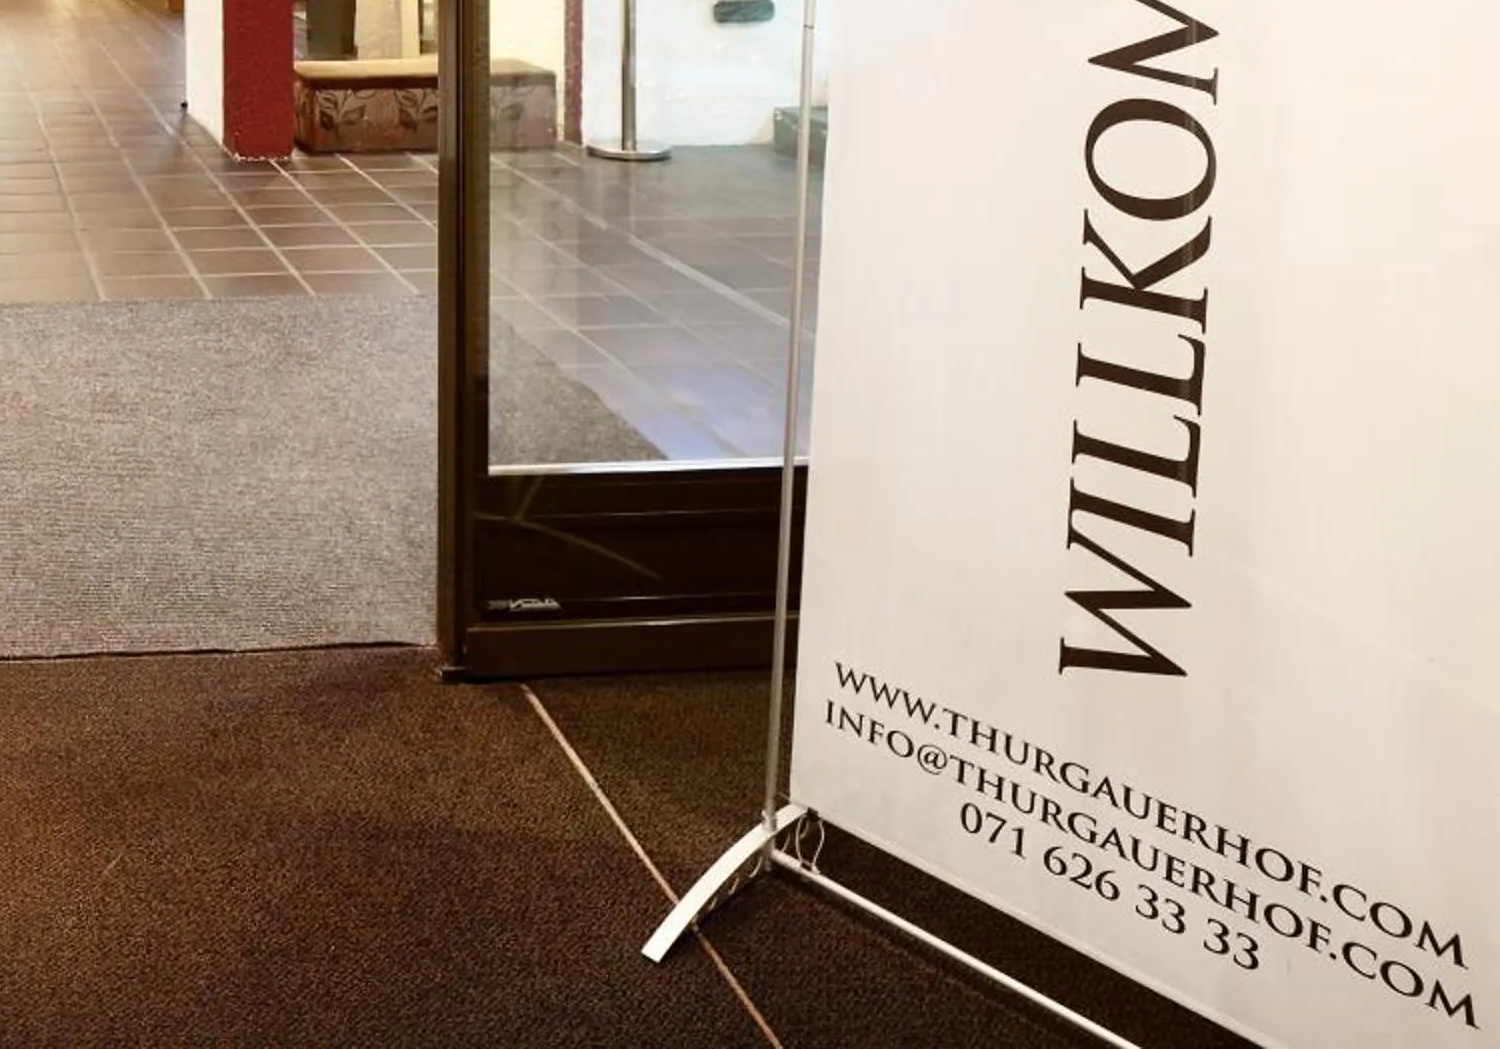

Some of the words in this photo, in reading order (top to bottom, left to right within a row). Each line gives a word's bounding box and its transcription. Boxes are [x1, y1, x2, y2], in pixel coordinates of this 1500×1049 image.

[825, 699, 1481, 1030] INFO@THURGAUERHOF.COM
[834, 661, 1469, 970] WWW.THURGAUERHOF.COM
[960, 801, 1026, 858] 071
[1043, 846, 1121, 902] 626
[1135, 883, 1187, 936] 33
[1203, 917, 1260, 971] 33
